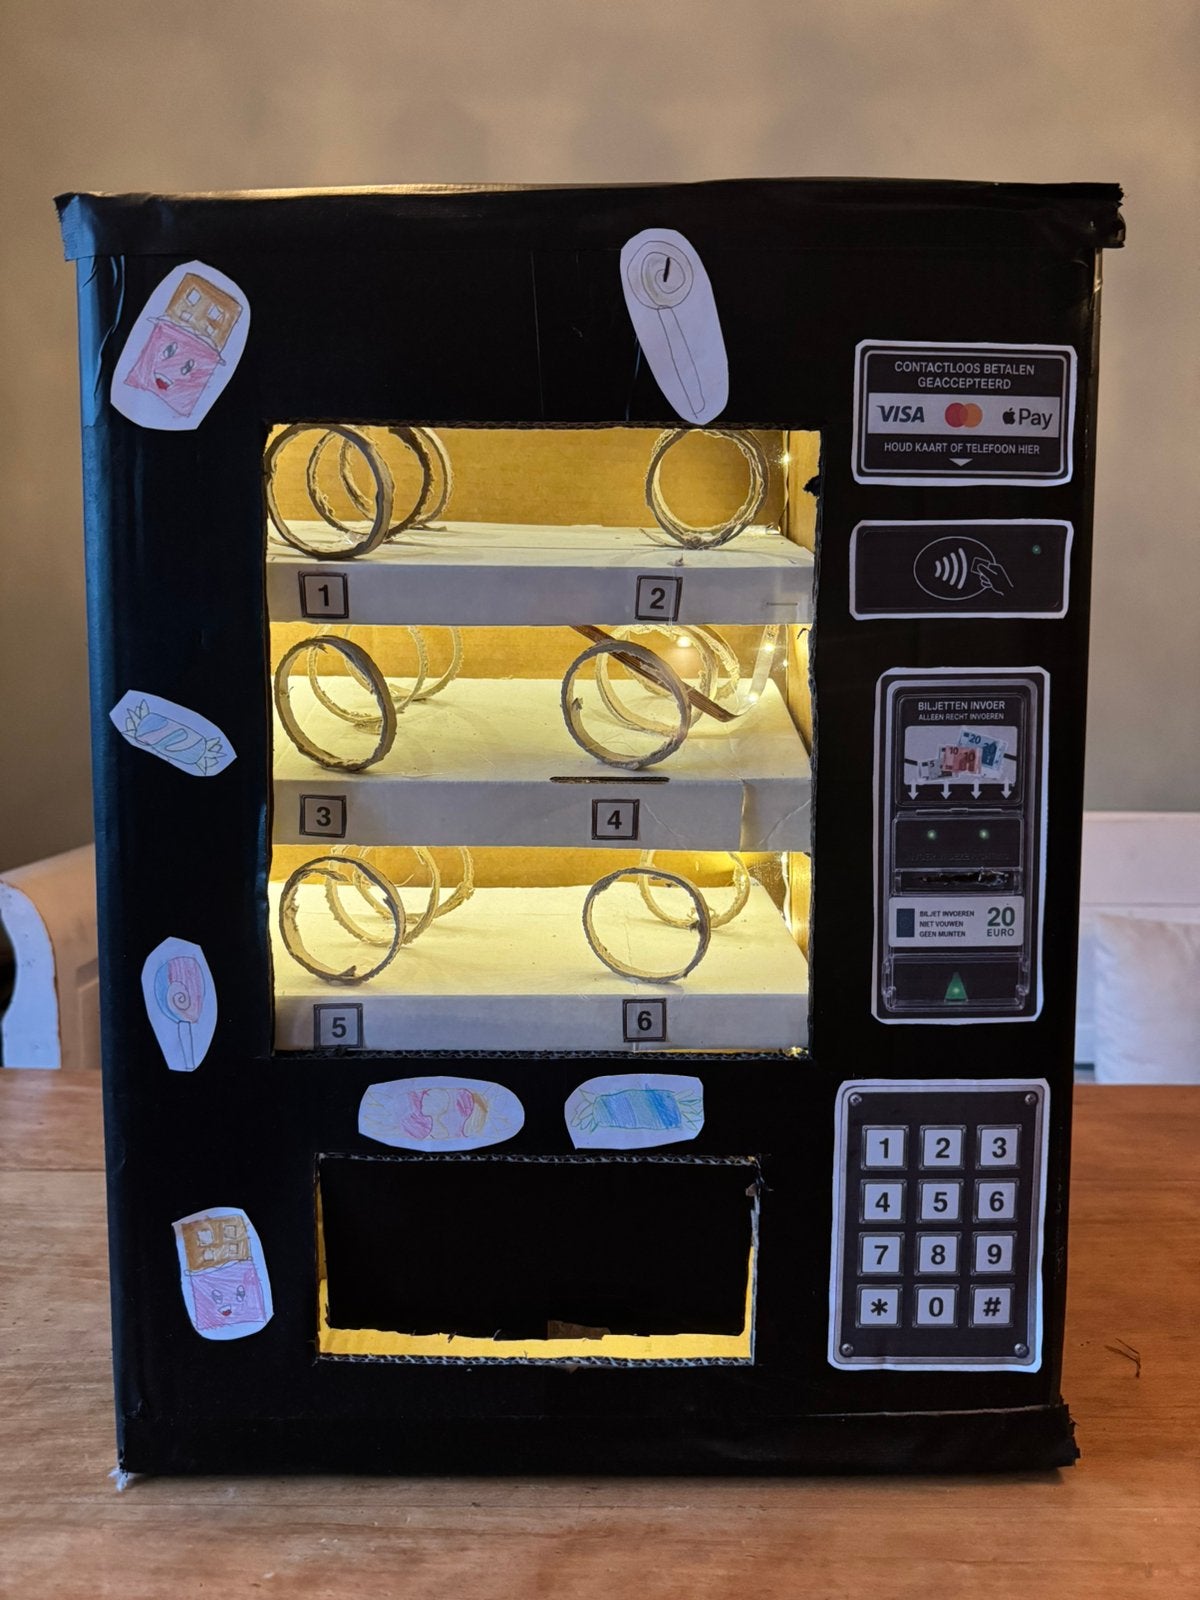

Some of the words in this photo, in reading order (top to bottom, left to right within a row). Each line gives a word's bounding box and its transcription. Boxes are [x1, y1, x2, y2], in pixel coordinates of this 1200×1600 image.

[895, 361, 980, 373] CONTACTLOOS
[984, 364, 1034, 375] BETALEN
[918, 378, 1011, 389] GEACCEPTEERD
[877, 405, 924, 423] VISA
[1018, 408, 1052, 430] Pay
[885, 442, 912, 452] HOUD
[915, 442, 947, 452] KAART
[951, 443, 963, 452] OF
[966, 443, 1016, 453] TELEFOON
[1018, 444, 1039, 454] HIER
[318, 584, 330, 607] 1
[650, 588, 666, 609] 2
[918, 702, 968, 710] BILJETTEN
[970, 701, 1005, 710] INVOER
[969, 734, 981, 744] 20
[316, 806, 331, 827] 3
[607, 810, 622, 830] 4
[987, 907, 1015, 926] 20
[987, 929, 1014, 937] EURO
[332, 1017, 347, 1039] 5
[637, 1011, 652, 1031] 6
[880, 1138, 890, 1158] 1
[935, 1138, 950, 1158] 2
[992, 1137, 1007, 1158] 3
[875, 1192, 890, 1212] 4
[934, 1192, 948, 1212] 5
[989, 1191, 1004, 1212] 6
[874, 1245, 889, 1264] 7
[931, 1245, 946, 1265] 8
[987, 1244, 1002, 1264] 9
[929, 1297, 943, 1317] 0
